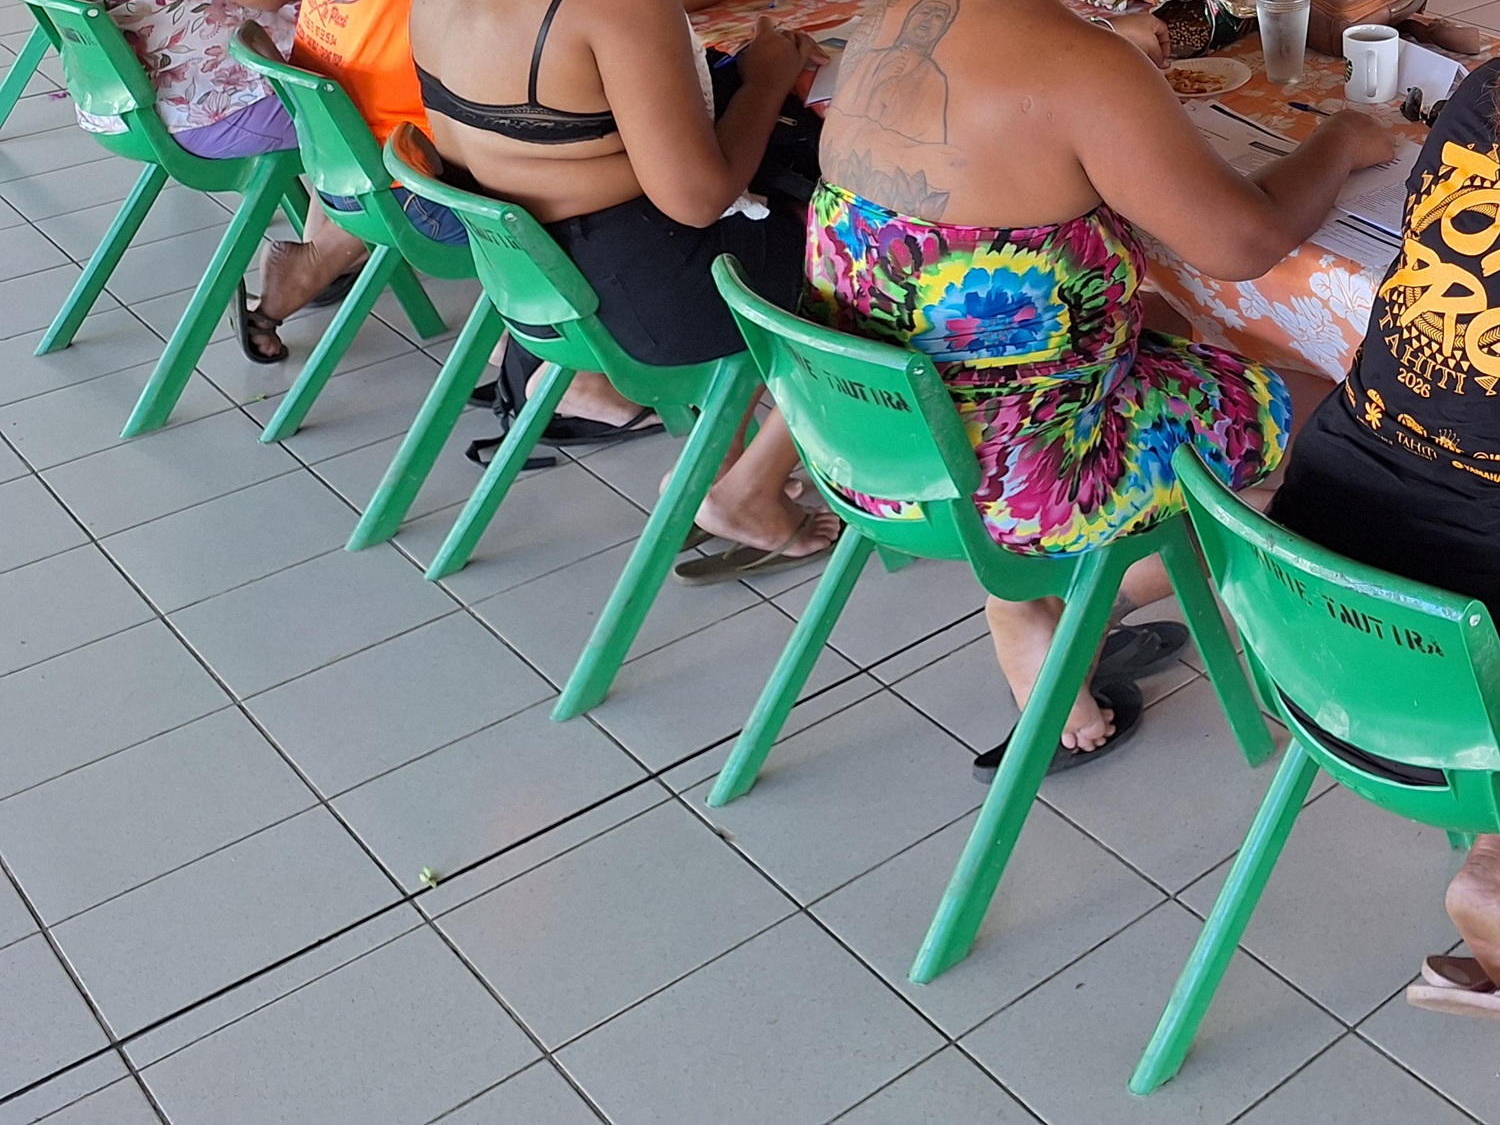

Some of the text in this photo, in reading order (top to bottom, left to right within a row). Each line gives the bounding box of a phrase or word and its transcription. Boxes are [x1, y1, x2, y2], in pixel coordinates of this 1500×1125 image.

[1378, 305, 1467, 396] TAHITI
[822, 369, 913, 413] TAUTIRA
[1396, 367, 1431, 399] 2026
[1395, 430, 1438, 460] TAHITI
[1320, 592, 1445, 658] TAUTIRA
